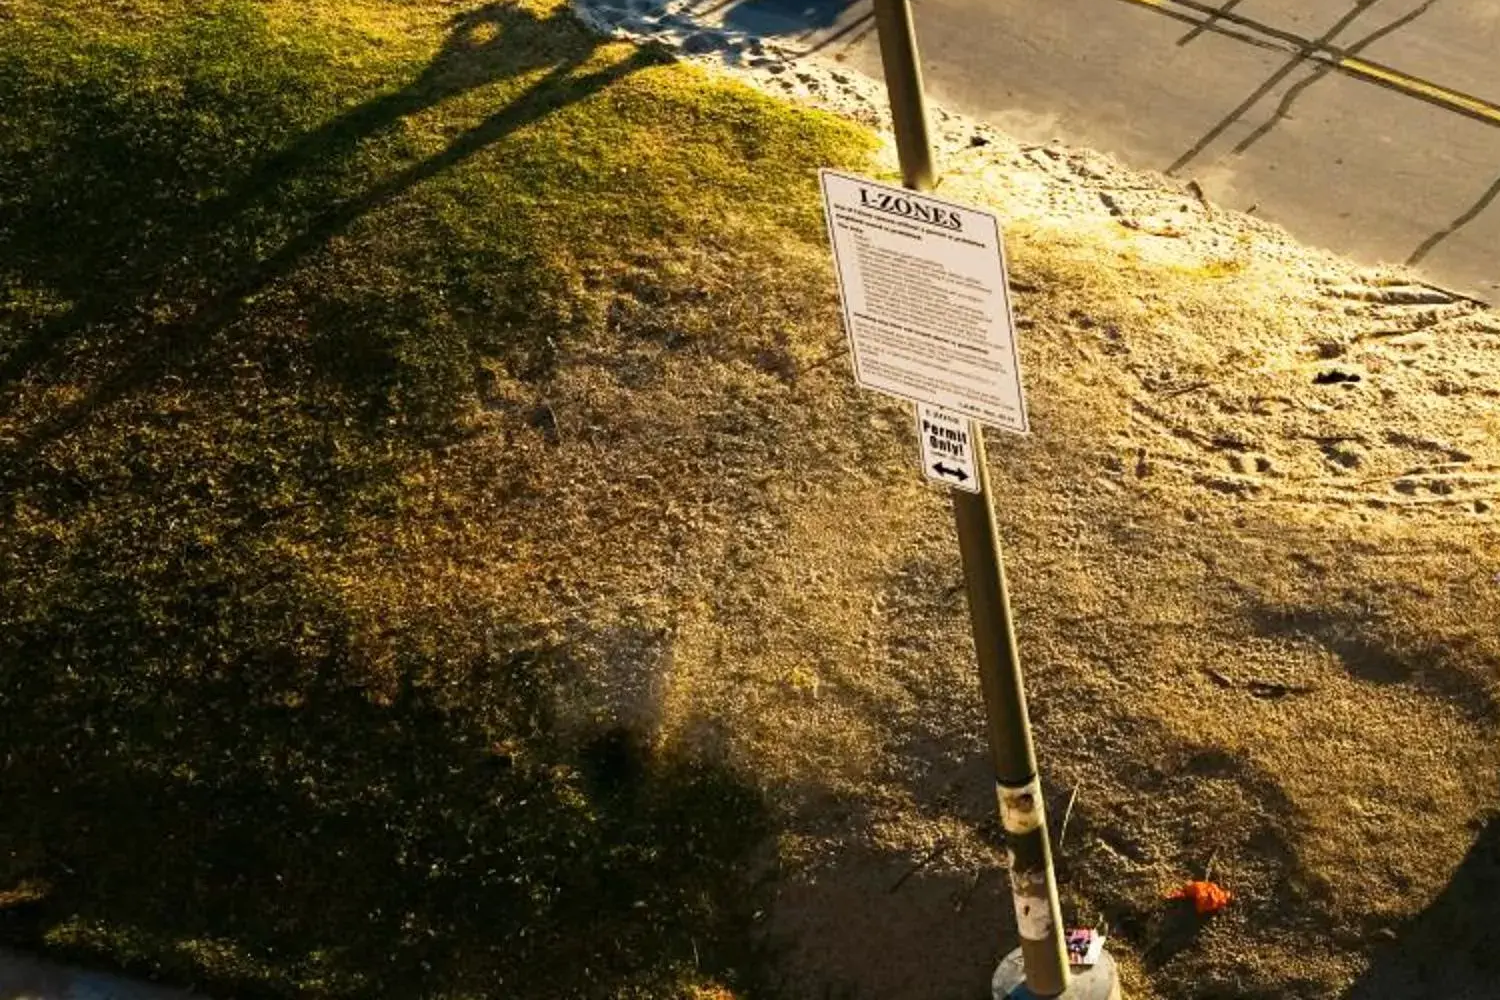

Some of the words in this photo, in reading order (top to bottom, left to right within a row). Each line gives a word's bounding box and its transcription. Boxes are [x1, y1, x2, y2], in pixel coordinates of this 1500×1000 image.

[859, 188, 963, 231] I-ZONES
[923, 419, 967, 445] Permit
[929, 434, 964, 457] Only!
